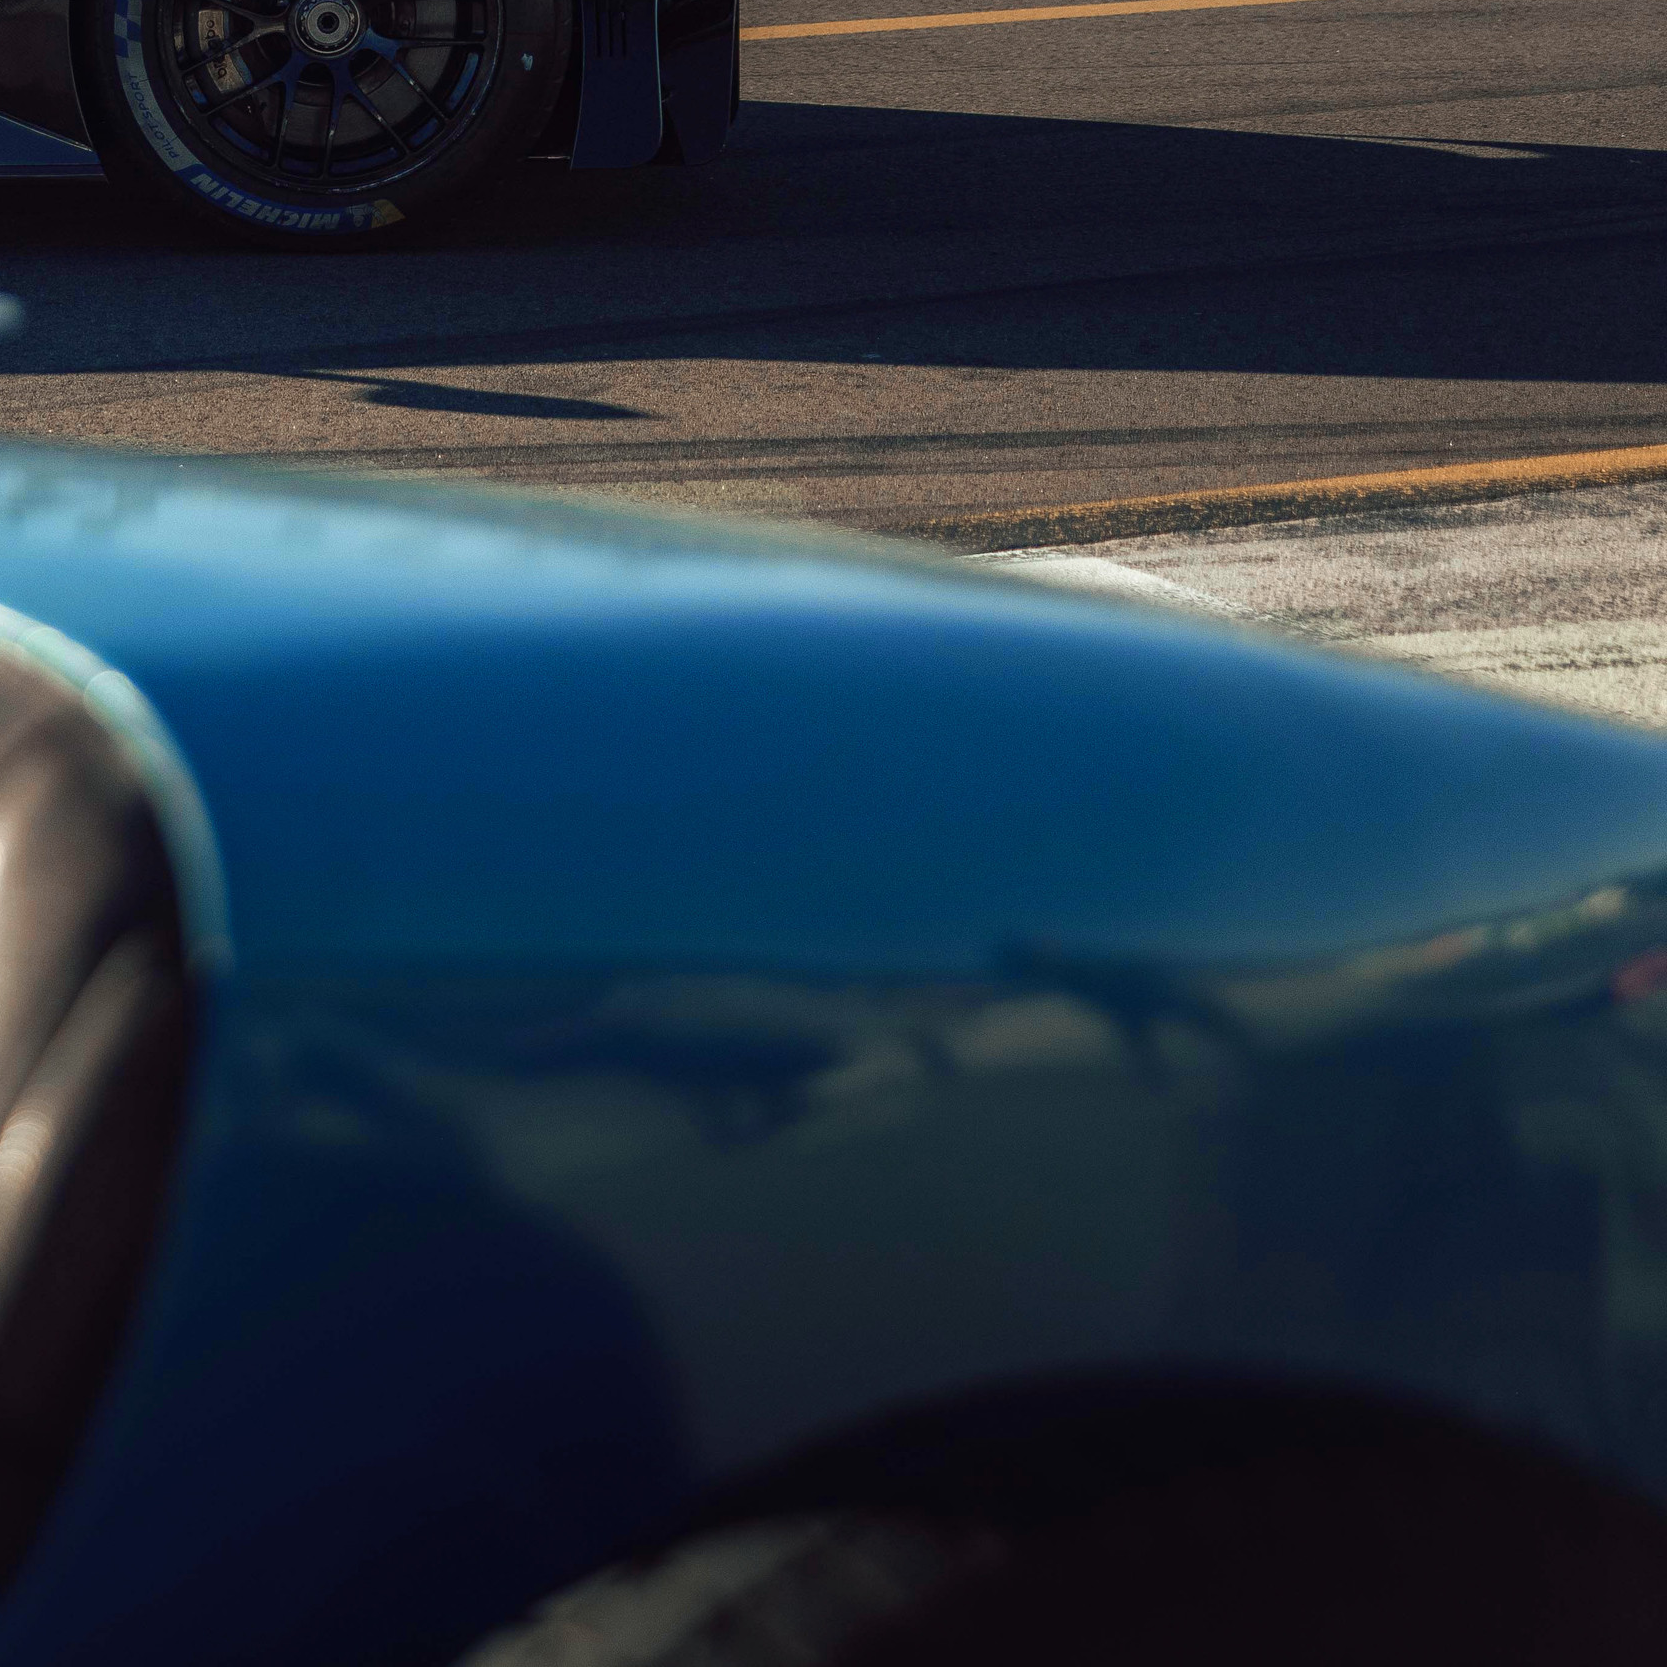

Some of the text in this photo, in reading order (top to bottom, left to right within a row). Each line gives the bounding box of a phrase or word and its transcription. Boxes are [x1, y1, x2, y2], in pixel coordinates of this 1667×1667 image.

[205, 19, 227, 79] brbo
[128, 72, 179, 159] PILOT SPORT
[190, 173, 341, 230] MICHELIN
